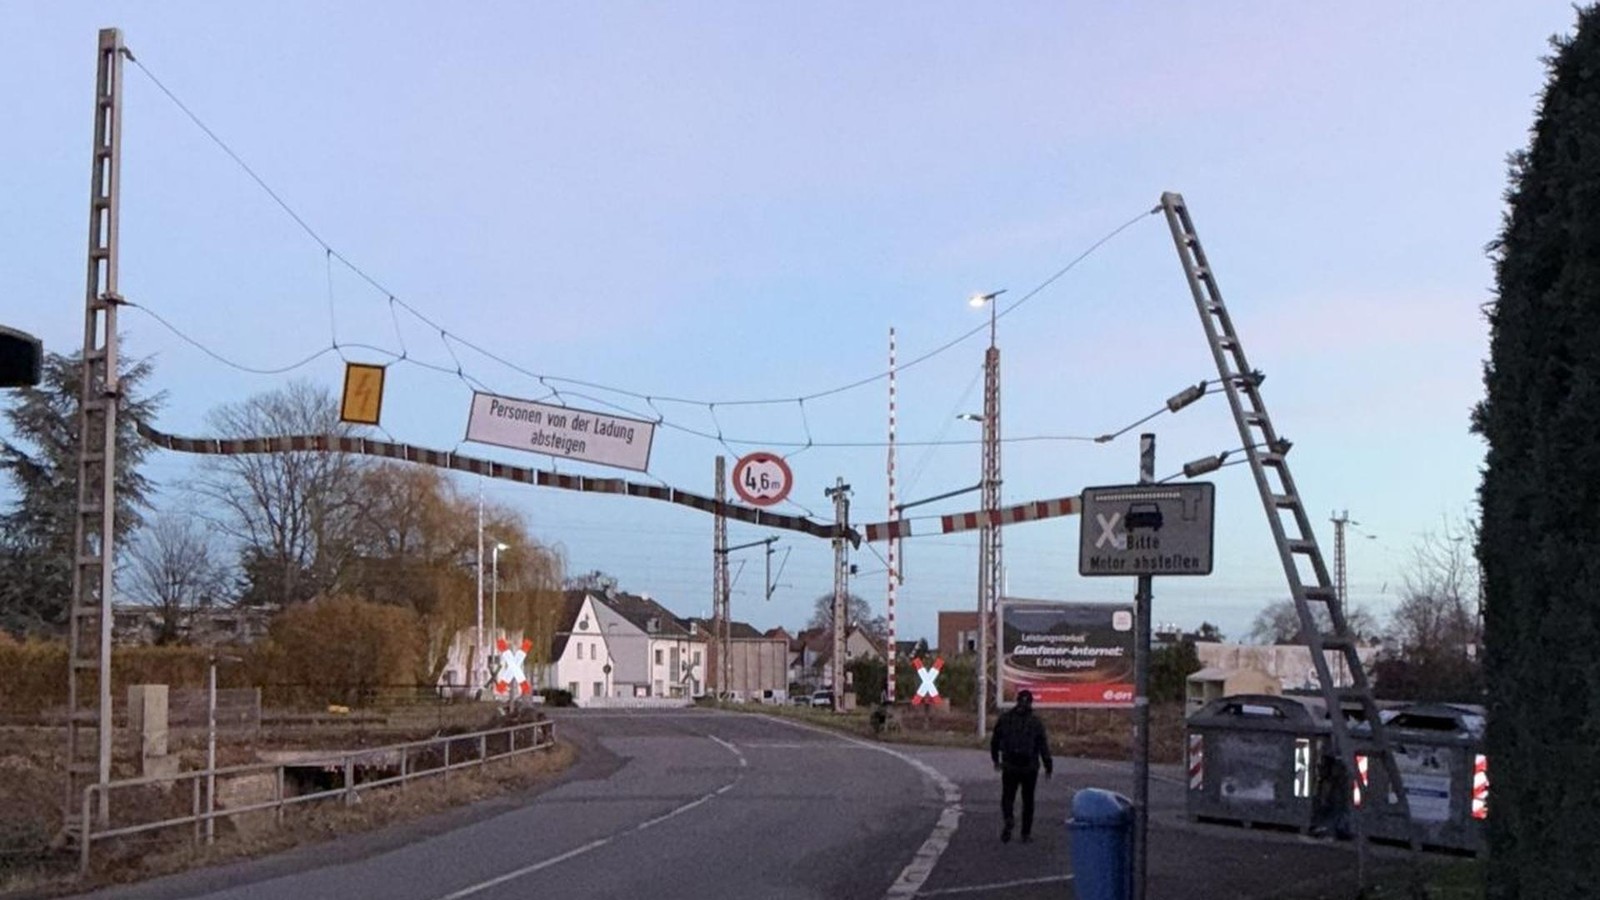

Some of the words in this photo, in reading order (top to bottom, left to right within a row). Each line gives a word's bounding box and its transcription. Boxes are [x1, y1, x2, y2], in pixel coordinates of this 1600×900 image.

[489, 398, 542, 424] Personen
[547, 413, 567, 428] von
[571, 414, 590, 432] der
[593, 418, 635, 444] Ladung
[530, 428, 586, 455] absteigen
[1126, 534, 1160, 550] Bitte
[1090, 555, 1126, 570] Motor
[1133, 554, 1200, 570] abstellen
